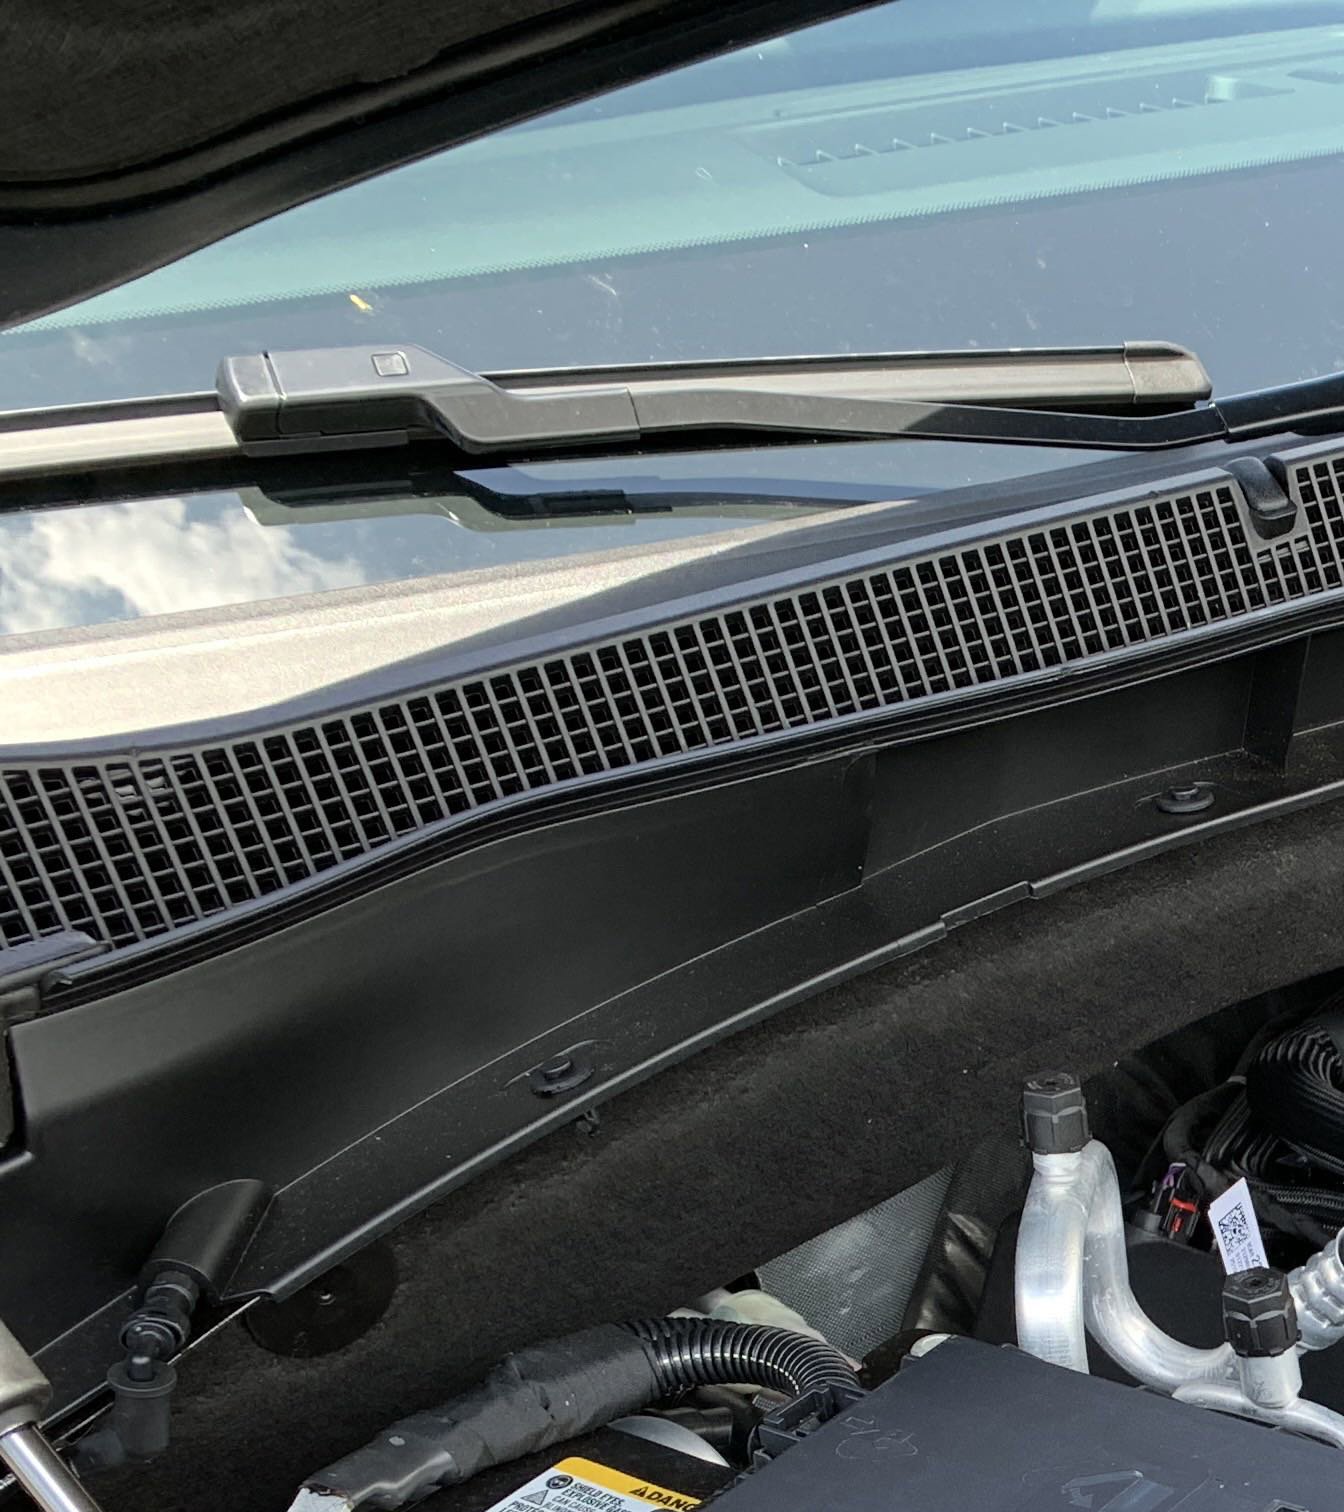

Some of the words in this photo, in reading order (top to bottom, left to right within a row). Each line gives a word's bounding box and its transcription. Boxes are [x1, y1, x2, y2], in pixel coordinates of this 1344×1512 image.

[570, 1482, 603, 1498] SHIELD
[551, 1495, 571, 1506] CAN
[561, 1488, 610, 1511] EXPLOSIVE
